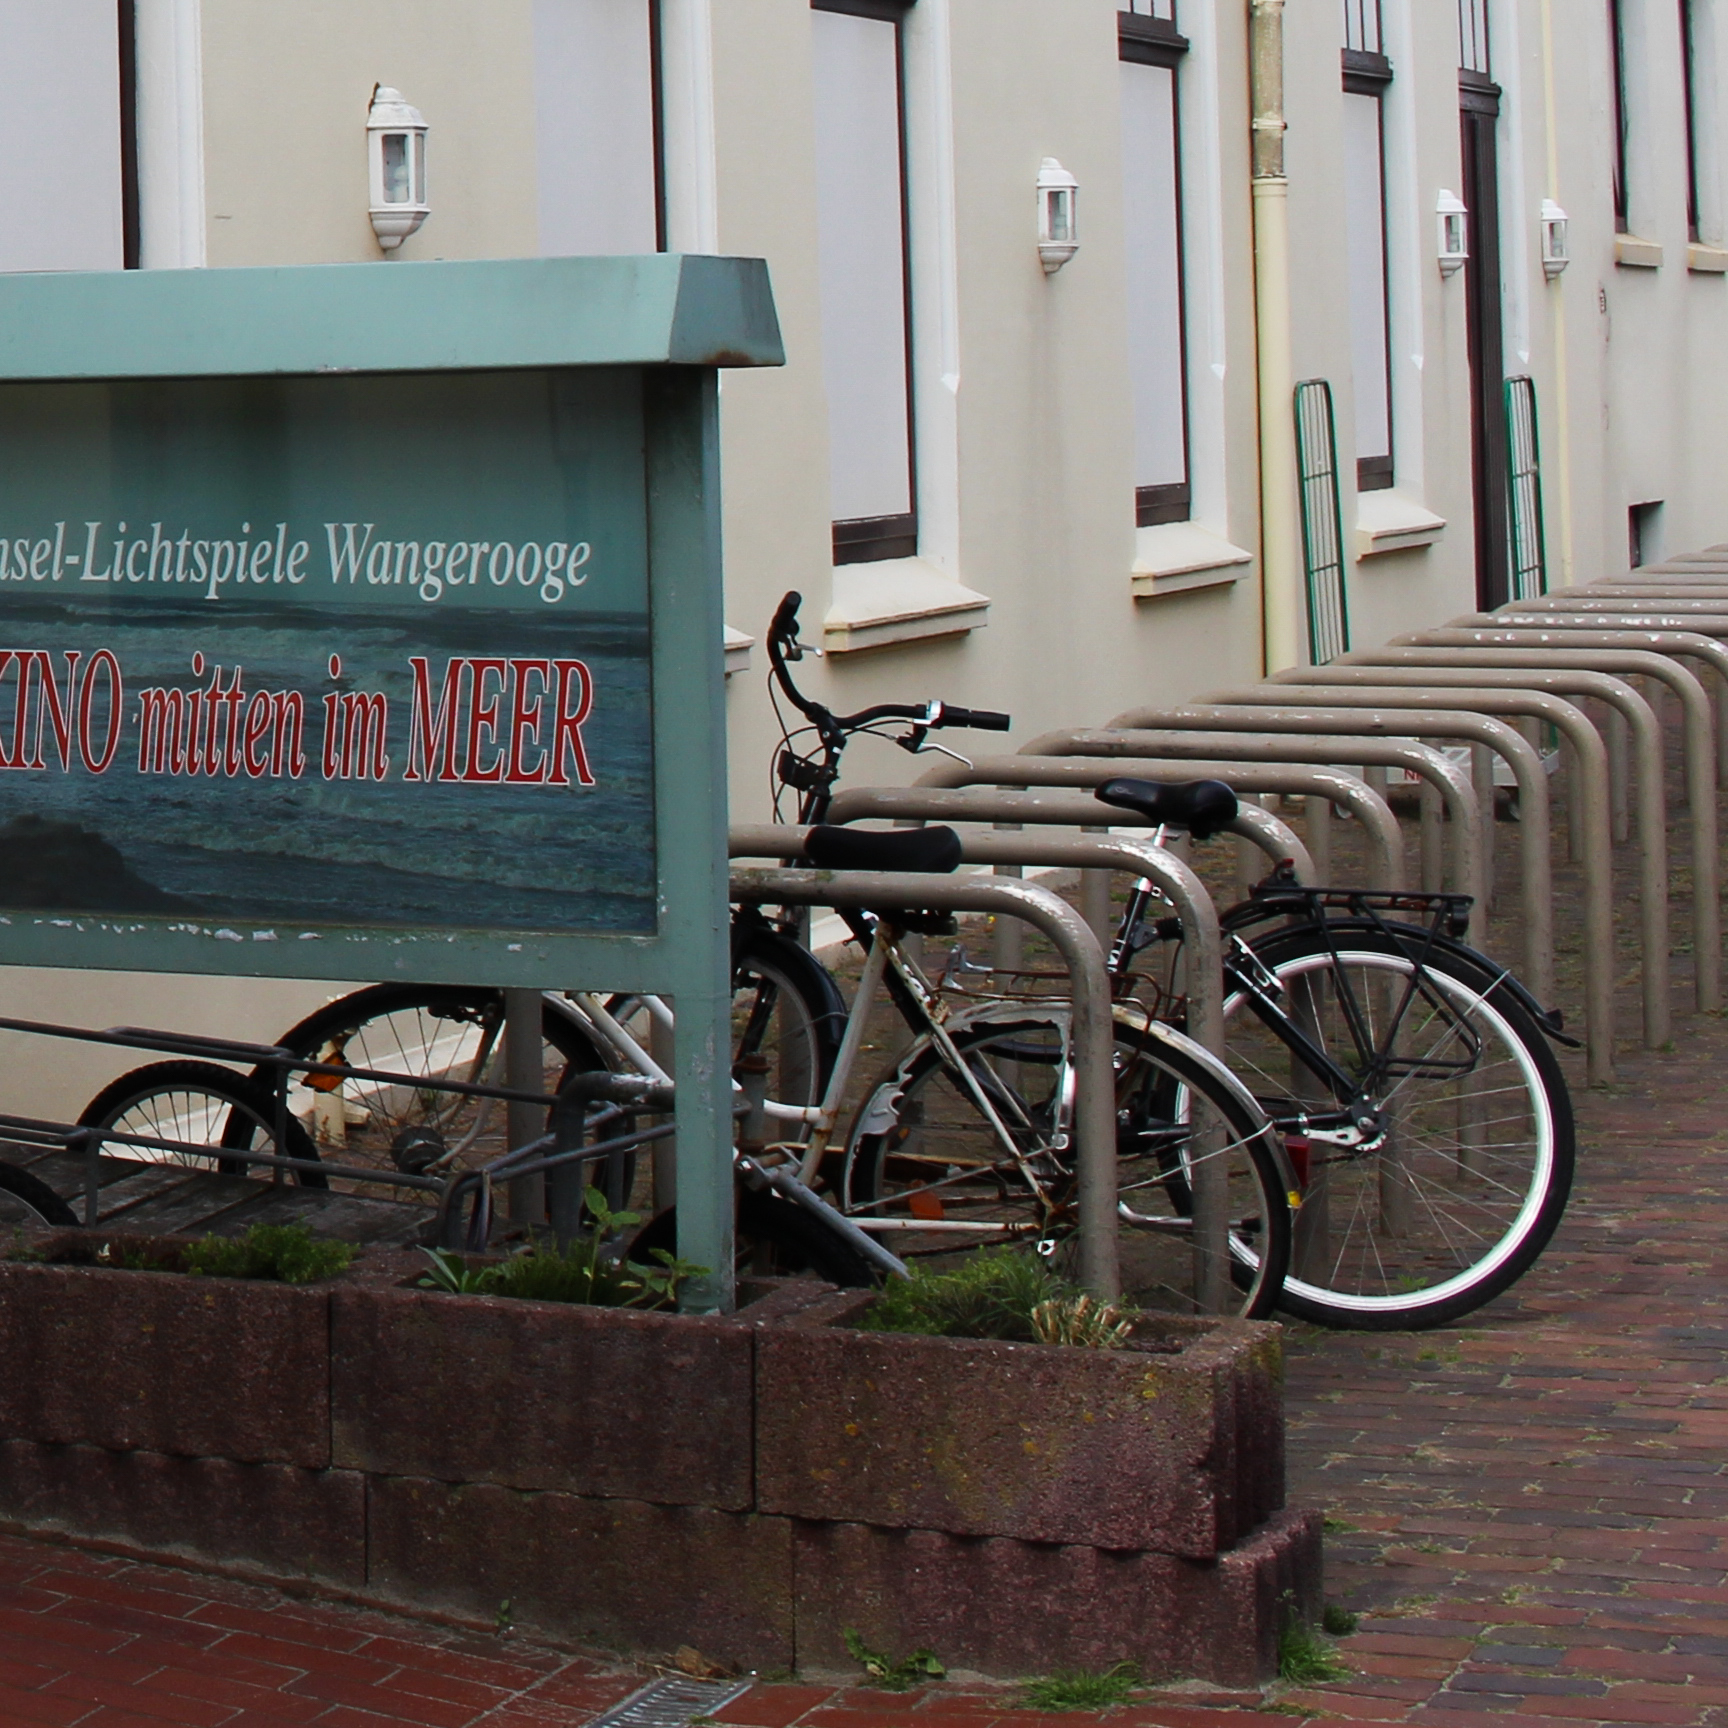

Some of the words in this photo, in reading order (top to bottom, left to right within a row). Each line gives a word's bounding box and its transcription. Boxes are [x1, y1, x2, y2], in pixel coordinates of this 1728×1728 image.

[323, 522, 592, 603] Wangerooge
[138, 650, 306, 779] mitten
[321, 652, 390, 781] im
[403, 656, 596, 786] MEER
